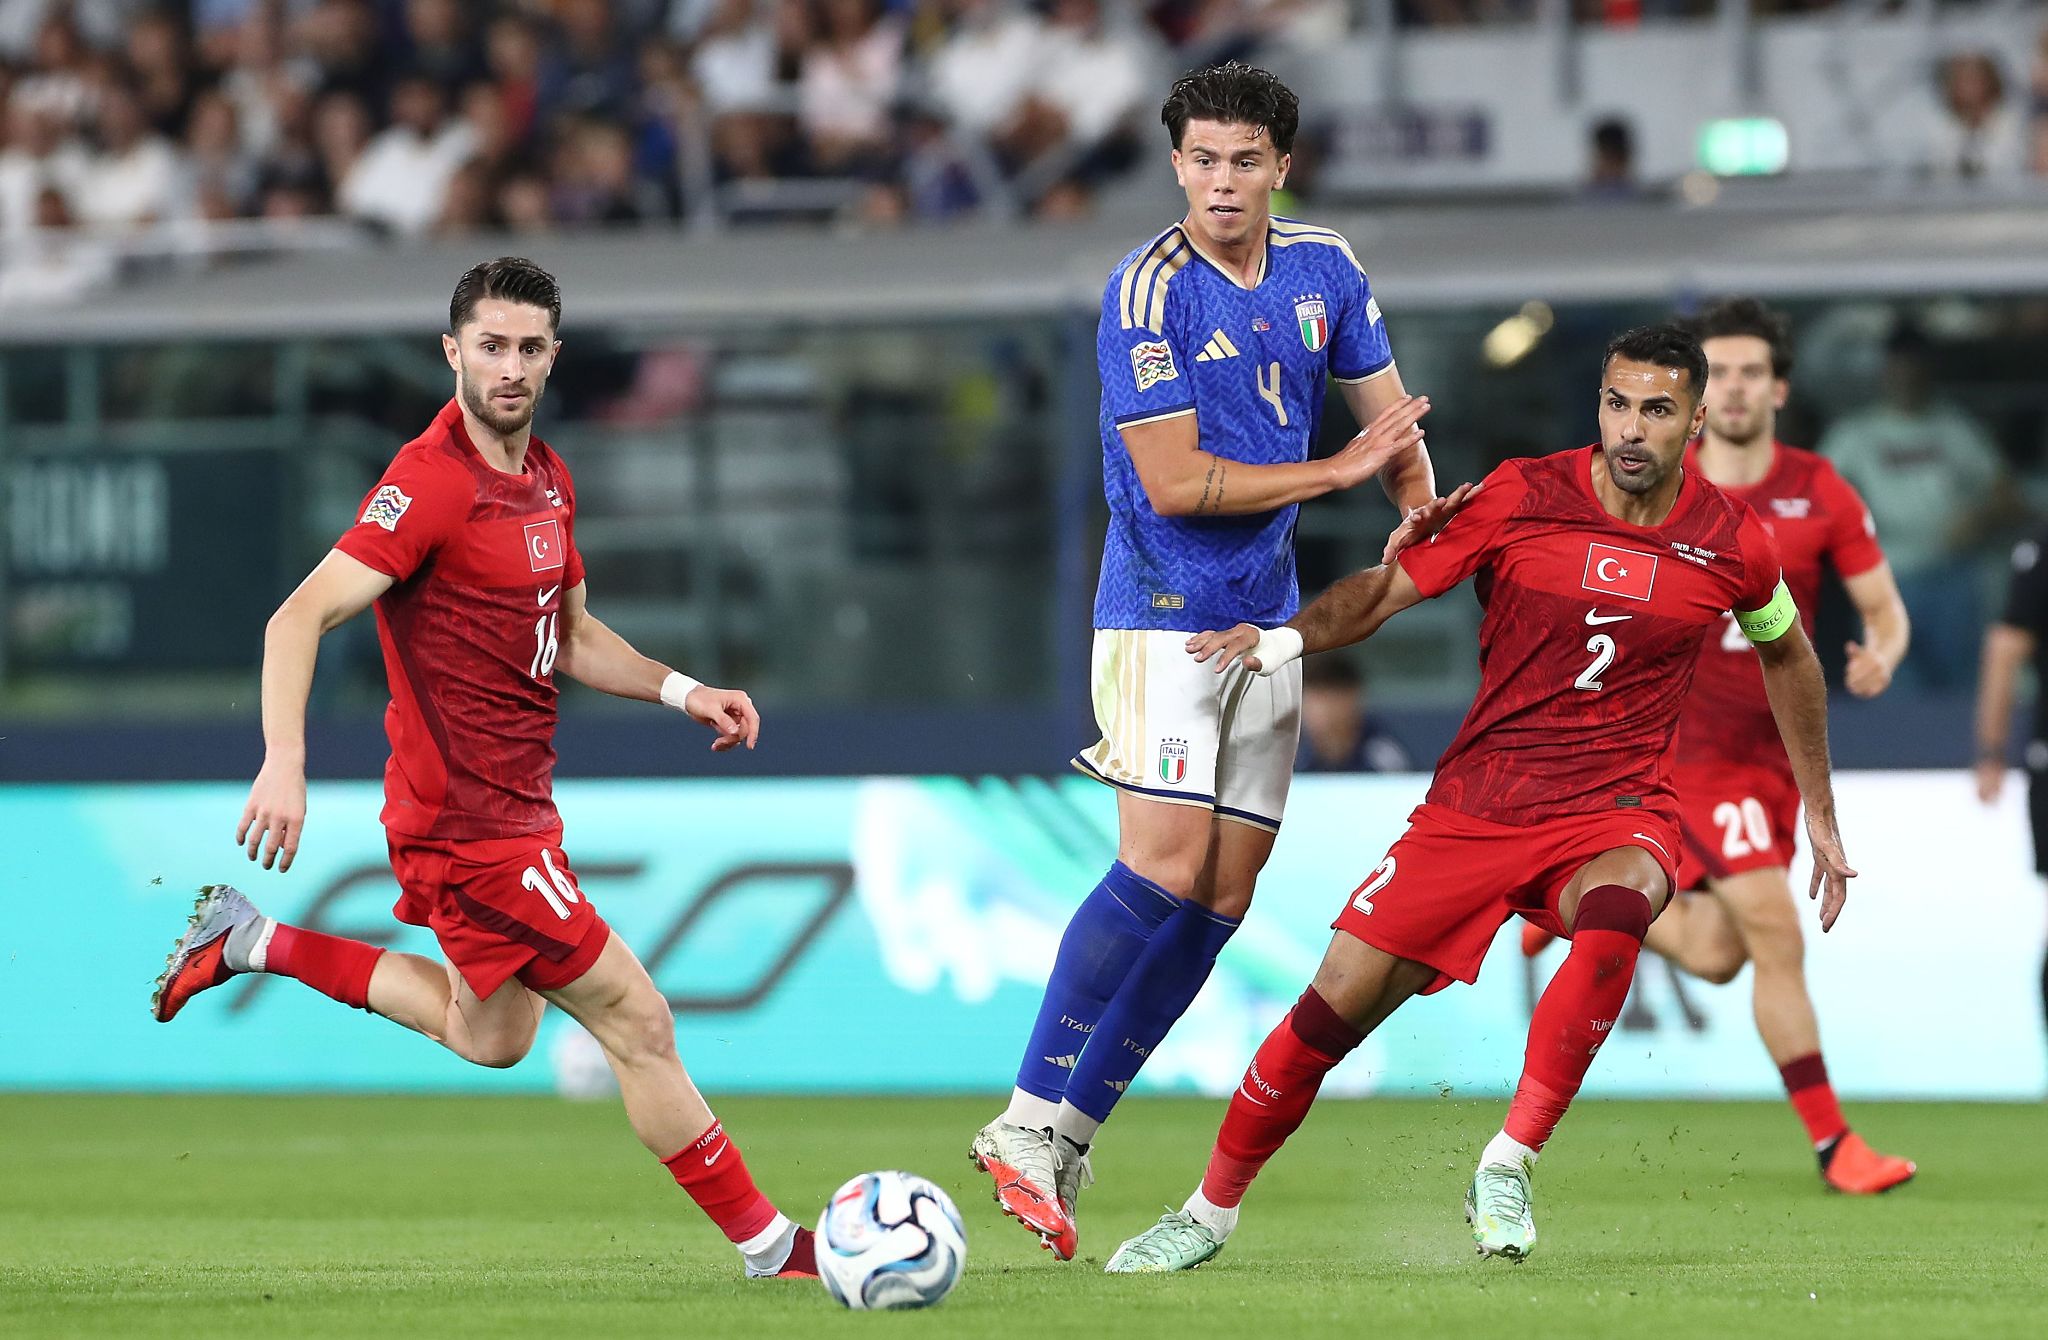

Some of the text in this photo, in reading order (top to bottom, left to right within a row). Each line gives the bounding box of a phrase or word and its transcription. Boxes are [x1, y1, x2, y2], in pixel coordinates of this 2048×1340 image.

[1299, 305, 1323, 317] ITALIA
[1257, 362, 1288, 427] 4
[530, 612, 559, 679] 16
[1743, 608, 1783, 631] RESPECT
[1574, 634, 1616, 691] 2
[1162, 746, 1185, 755] ITALIA
[1713, 798, 1771, 859] 20
[521, 848, 579, 920] 16
[1352, 855, 1397, 916] 2
